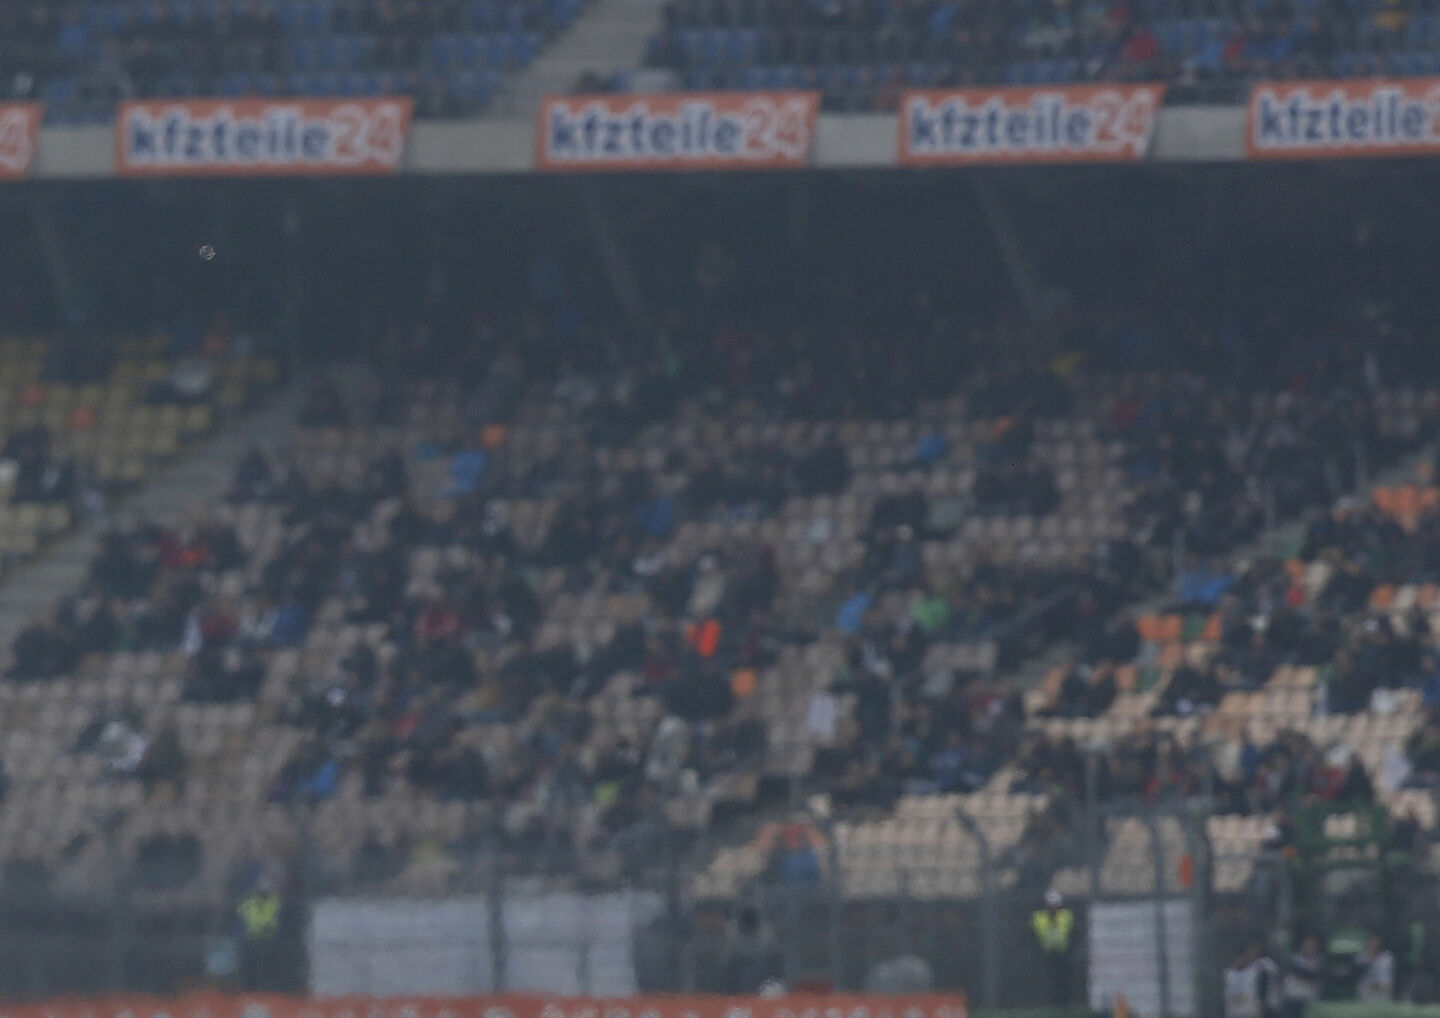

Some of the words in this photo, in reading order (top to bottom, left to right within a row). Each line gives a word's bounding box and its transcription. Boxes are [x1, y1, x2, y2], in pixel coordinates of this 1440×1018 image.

[122, 104, 402, 166] kfzteile24
[545, 99, 808, 163] kfzteile24
[907, 88, 1152, 156] kfzteile24
